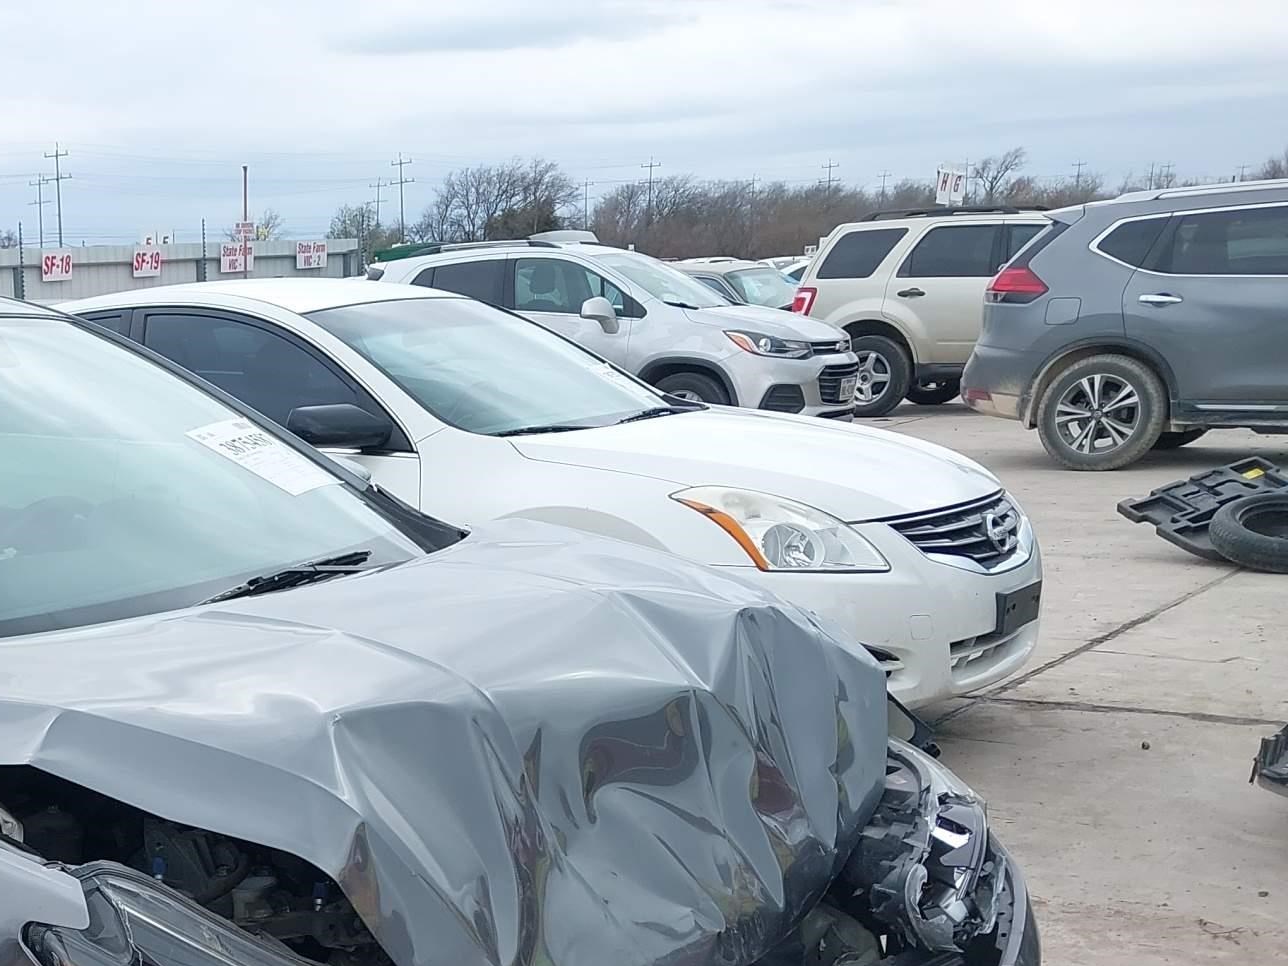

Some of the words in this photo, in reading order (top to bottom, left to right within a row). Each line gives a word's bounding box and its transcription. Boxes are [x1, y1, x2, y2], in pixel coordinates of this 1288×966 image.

[941, 173, 950, 191] H
[953, 175, 962, 192] G
[222, 245, 237, 257] State
[238, 245, 252, 257] Fam
[297, 242, 312, 254] State
[312, 242, 325, 253] Farm
[44, 254, 71, 275] SF-18
[135, 251, 160, 272] SF-19
[228, 258, 237, 270] VIC
[304, 255, 312, 267] VIC
[317, 254, 321, 266] 2
